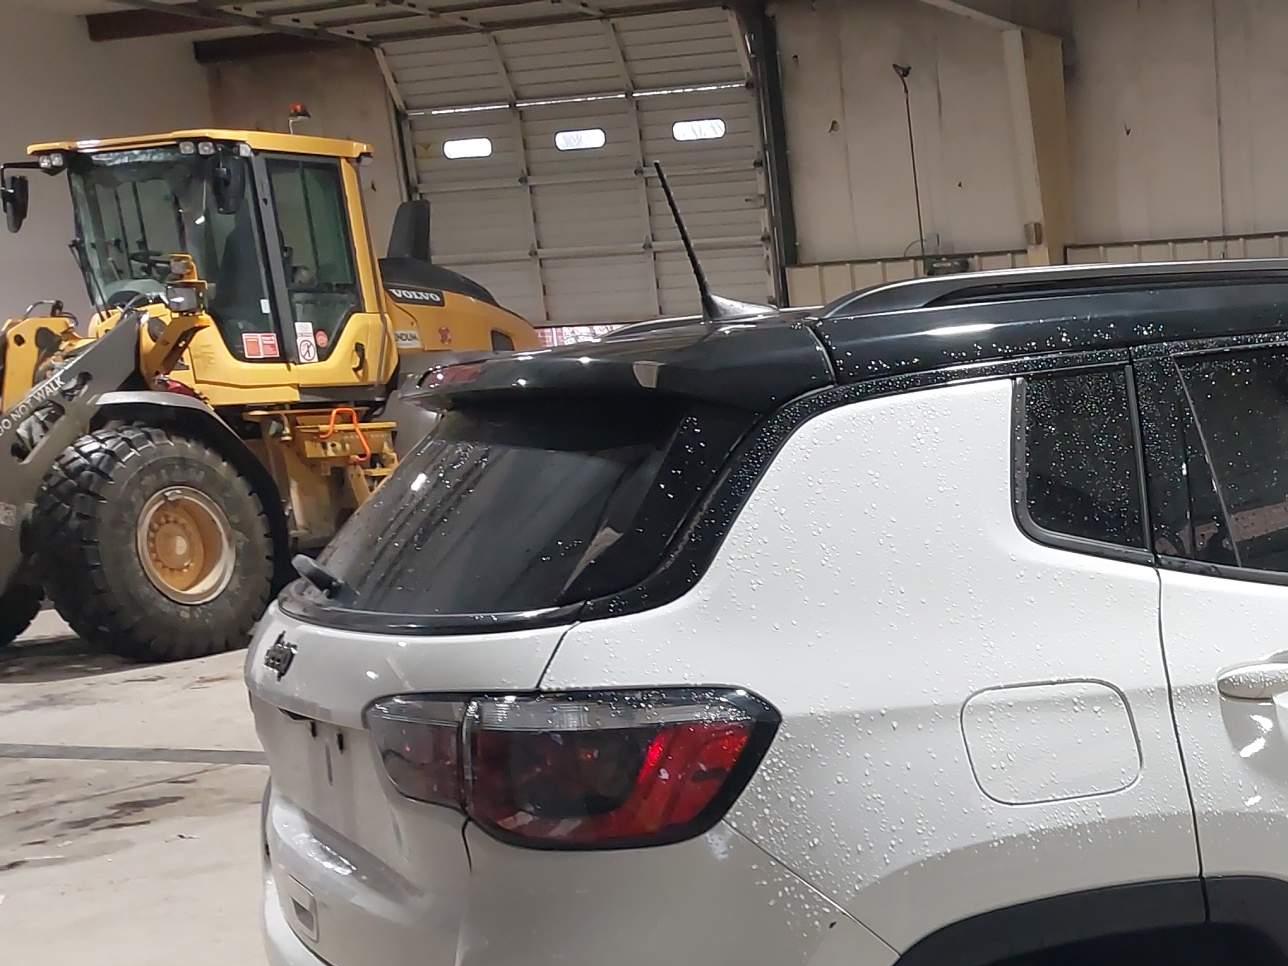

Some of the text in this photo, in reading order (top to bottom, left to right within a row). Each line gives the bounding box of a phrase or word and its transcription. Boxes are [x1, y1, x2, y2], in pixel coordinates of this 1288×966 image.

[388, 288, 441, 302] VOLVO
[10, 398, 34, 422] NOT
[32, 376, 66, 402] WALK
